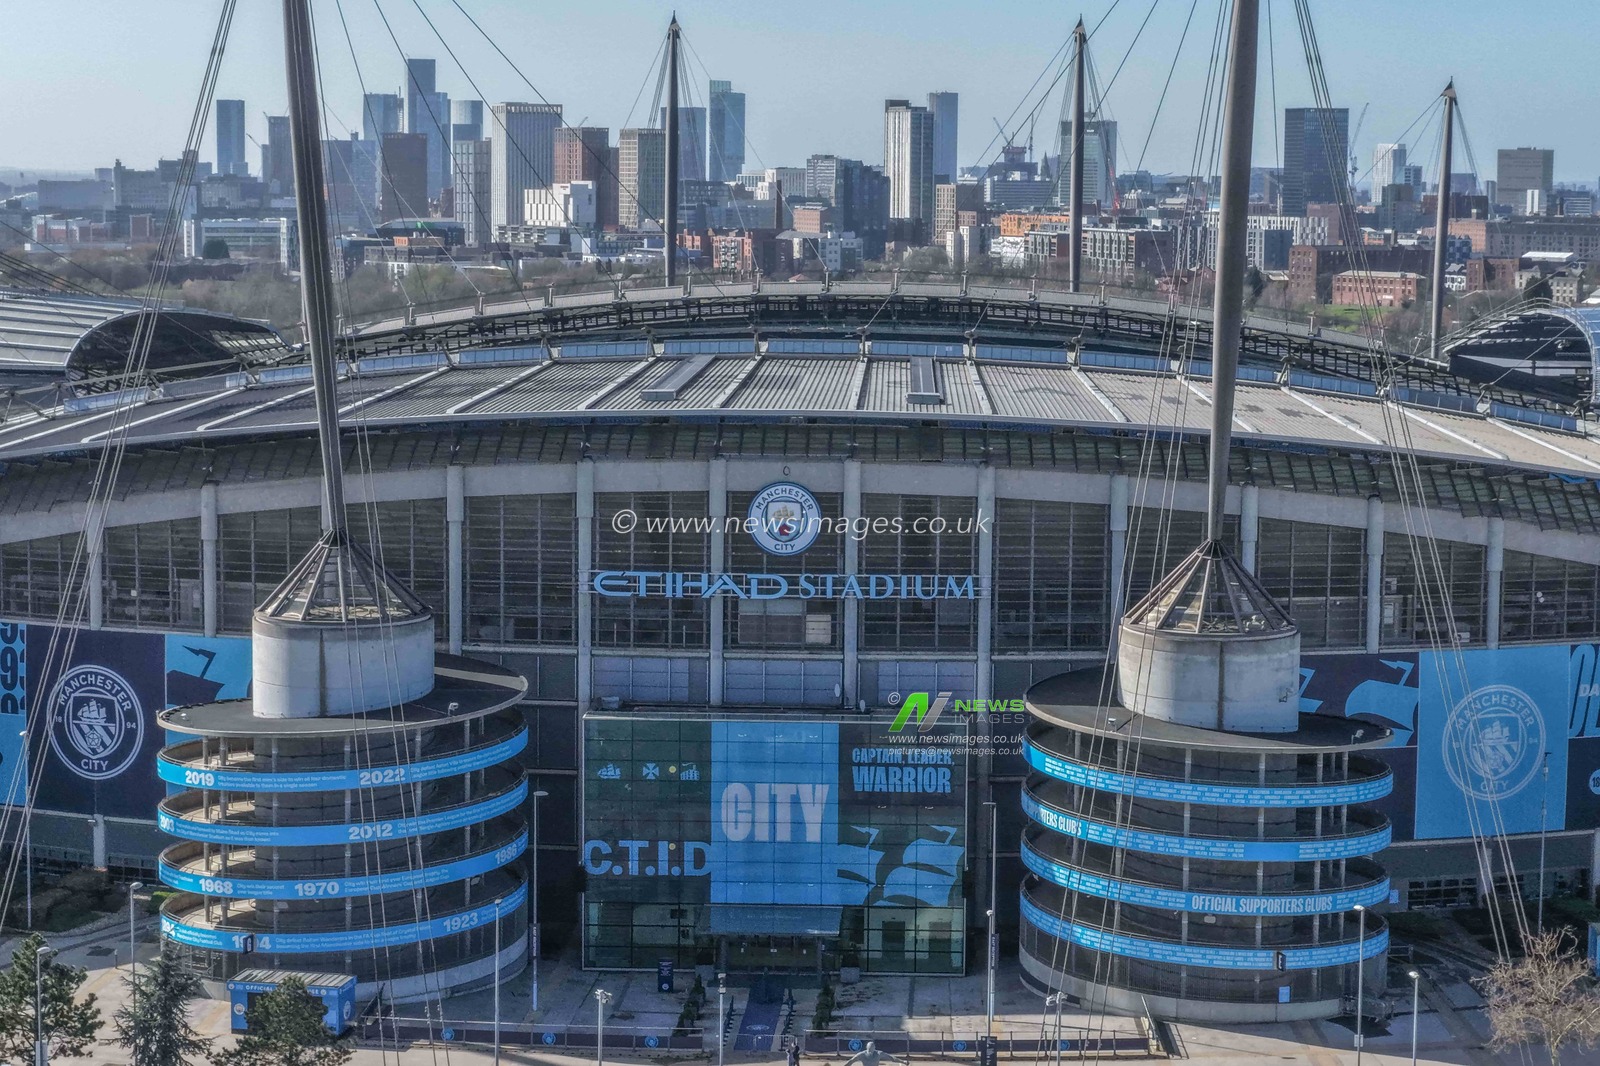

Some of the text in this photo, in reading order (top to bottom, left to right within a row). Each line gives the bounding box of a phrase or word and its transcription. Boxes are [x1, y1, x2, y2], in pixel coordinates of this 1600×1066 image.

[756, 488, 813, 511] MANCHESTER
[593, 571, 975, 599] ETIHAD STADIUM
[59, 674, 132, 711] MANCHESTER
[1457, 694, 1535, 730] MANCHESTER
[81, 759, 109, 771] CITY
[185, 770, 215, 787] 2019
[360, 769, 406, 785] 2022
[852, 766, 951, 793] WARRIOR
[721, 783, 829, 842] CITY
[348, 823, 392, 840] 2012
[584, 840, 711, 876] C.T.I.D
[198, 878, 233, 895] 1968
[294, 881, 340, 896] 1970
[1191, 895, 1237, 913] OFFICIAL
[1240, 897, 1304, 914] SUPPORTERS
[1305, 895, 1333, 912] CLUBS
[443, 912, 479, 933] 1923
[232, 935, 272, 951] 14
